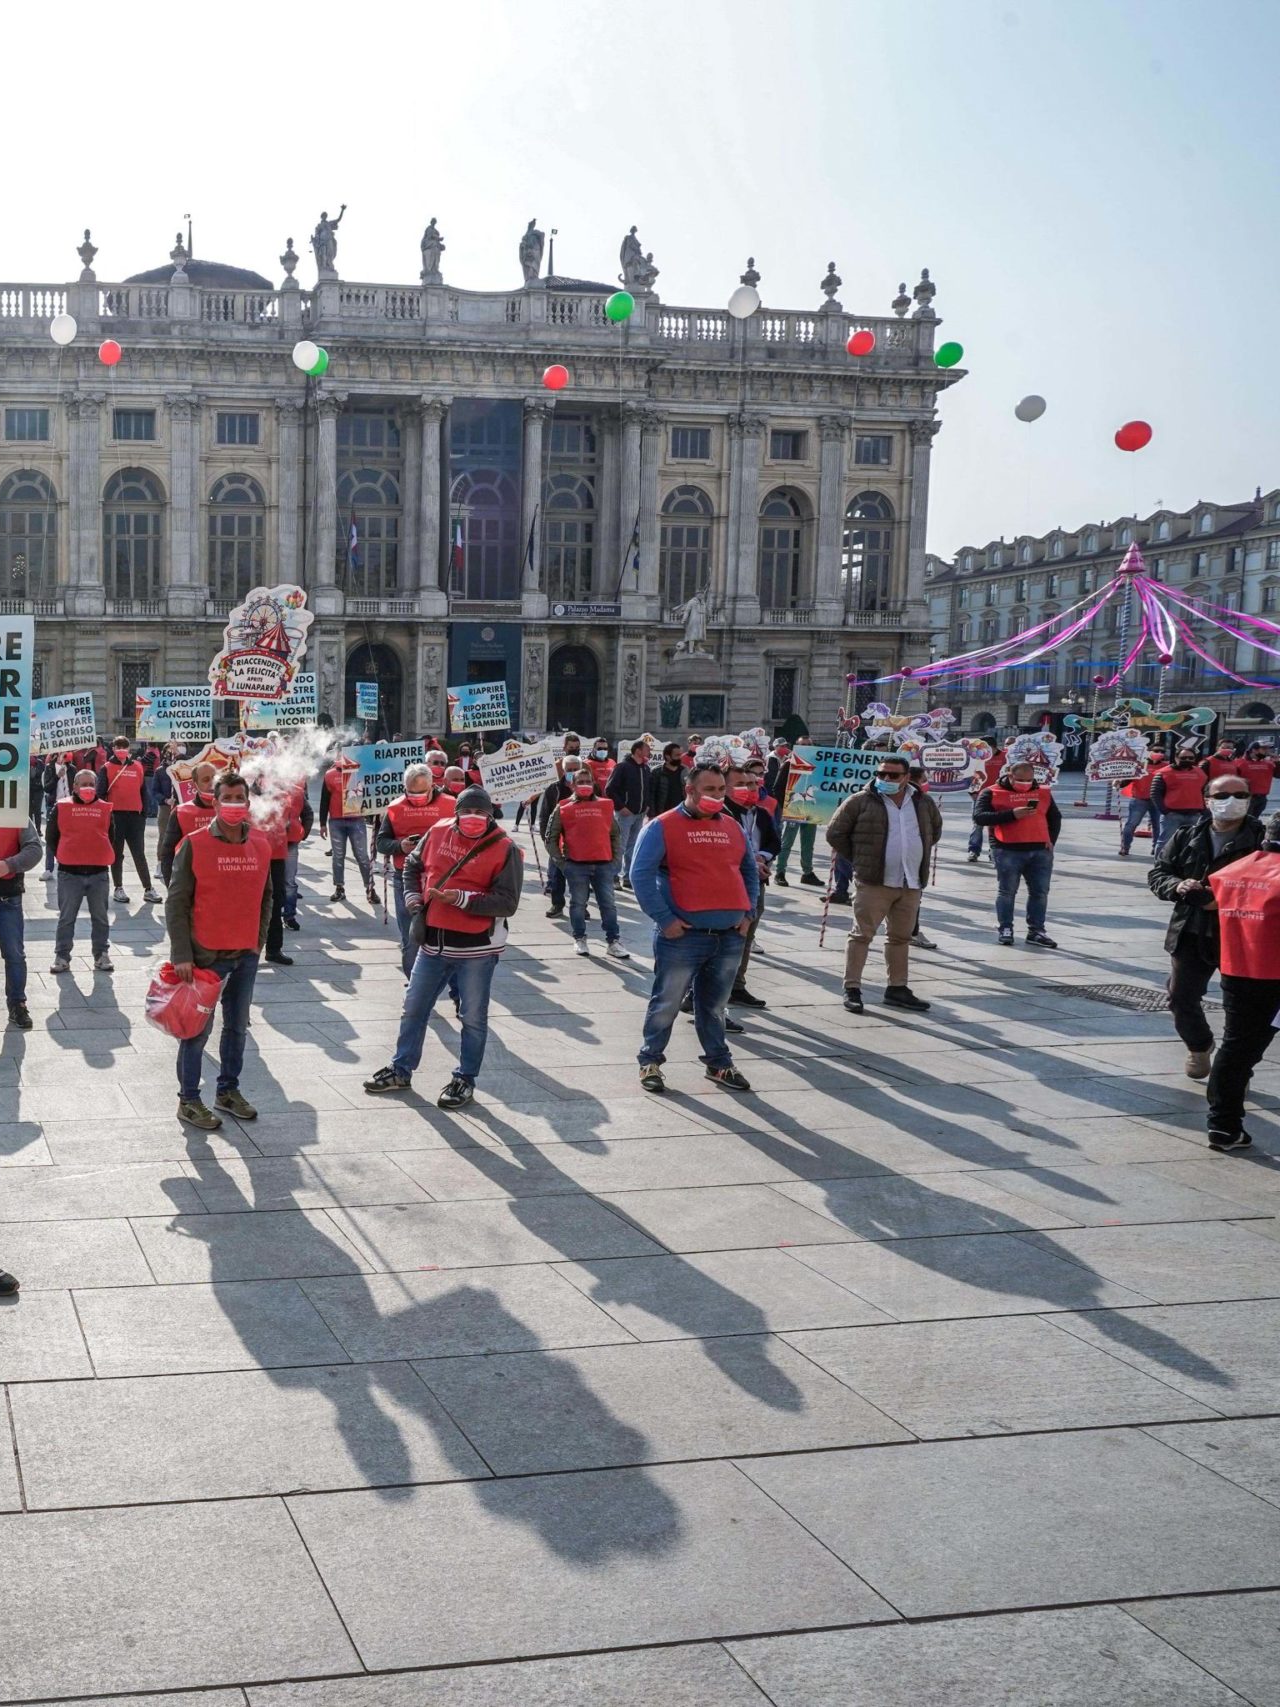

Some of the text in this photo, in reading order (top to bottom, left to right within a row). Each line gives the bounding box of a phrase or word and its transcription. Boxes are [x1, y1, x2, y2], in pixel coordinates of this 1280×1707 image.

[236, 658, 282, 672] RIACCENDETE
[234, 668, 244, 676] LA
[236, 683, 275, 692] LUNAPARK
[294, 686, 314, 694] STRE
[468, 685, 504, 696] RIAPRIRE
[151, 689, 210, 698] SPEGNENDO
[490, 694, 504, 702] PER
[48, 697, 90, 710] RIAPRIRE
[170, 700, 210, 708] GIOSTRE
[464, 701, 506, 712] RIPORTARE
[74, 706, 92, 716] PER
[157, 710, 210, 718] CANCELLATE
[281, 706, 315, 716] VOSTRI
[472, 710, 506, 720] SORRISO
[40, 716, 92, 730] RIPORTARE
[472, 718, 508, 728] BAMBINI
[40, 726, 93, 740] IL SORRISO
[39, 735, 94, 750] AI BAMBINI
[374, 746, 422, 760] RIAPRIRE
[816, 751, 884, 766] SPEGNEN
[490, 757, 544, 776] LUNA PARK
[364, 772, 404, 784] RIPORT
[824, 767, 838, 778] LE
[362, 784, 405, 797] IL SORR
[360, 800, 372, 811] AI
